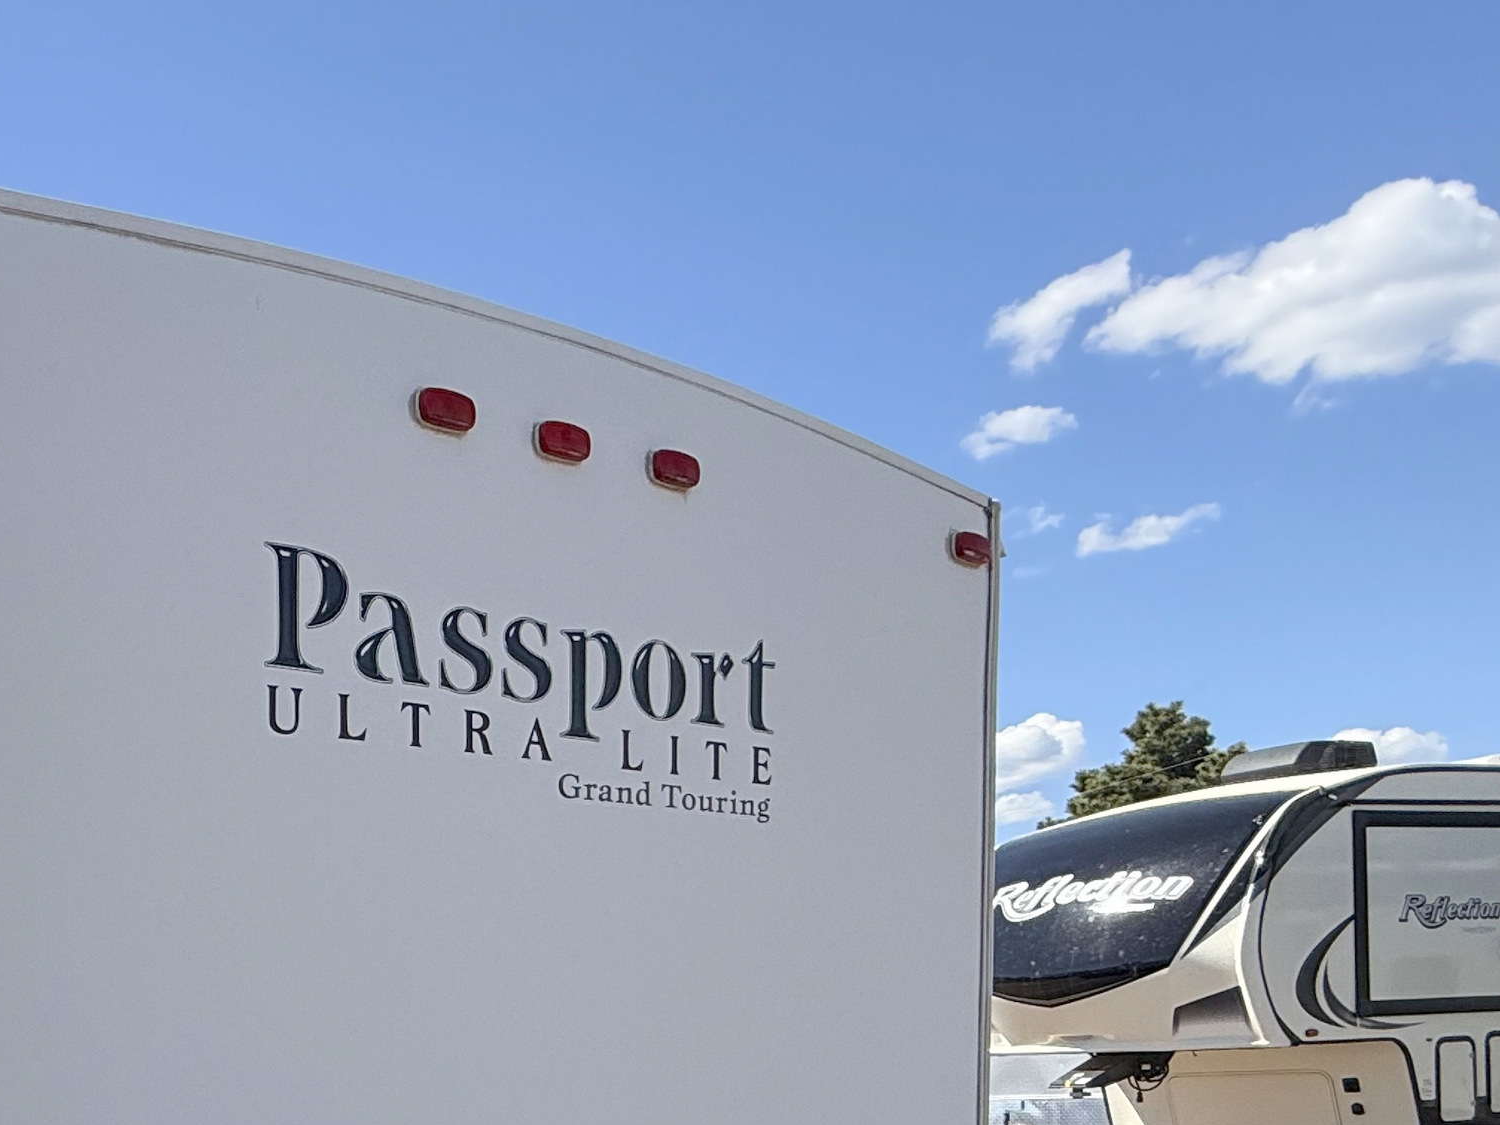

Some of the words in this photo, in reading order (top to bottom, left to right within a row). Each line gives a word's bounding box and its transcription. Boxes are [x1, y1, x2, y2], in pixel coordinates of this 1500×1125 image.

[263, 540, 776, 742] Passport
[267, 684, 552, 762] ULTRA
[621, 729, 773, 785] LITE
[558, 773, 651, 808] Grand
[660, 783, 772, 824] Touring
[993, 871, 1194, 922] Reflection
[1398, 893, 1500, 929] Reflection
